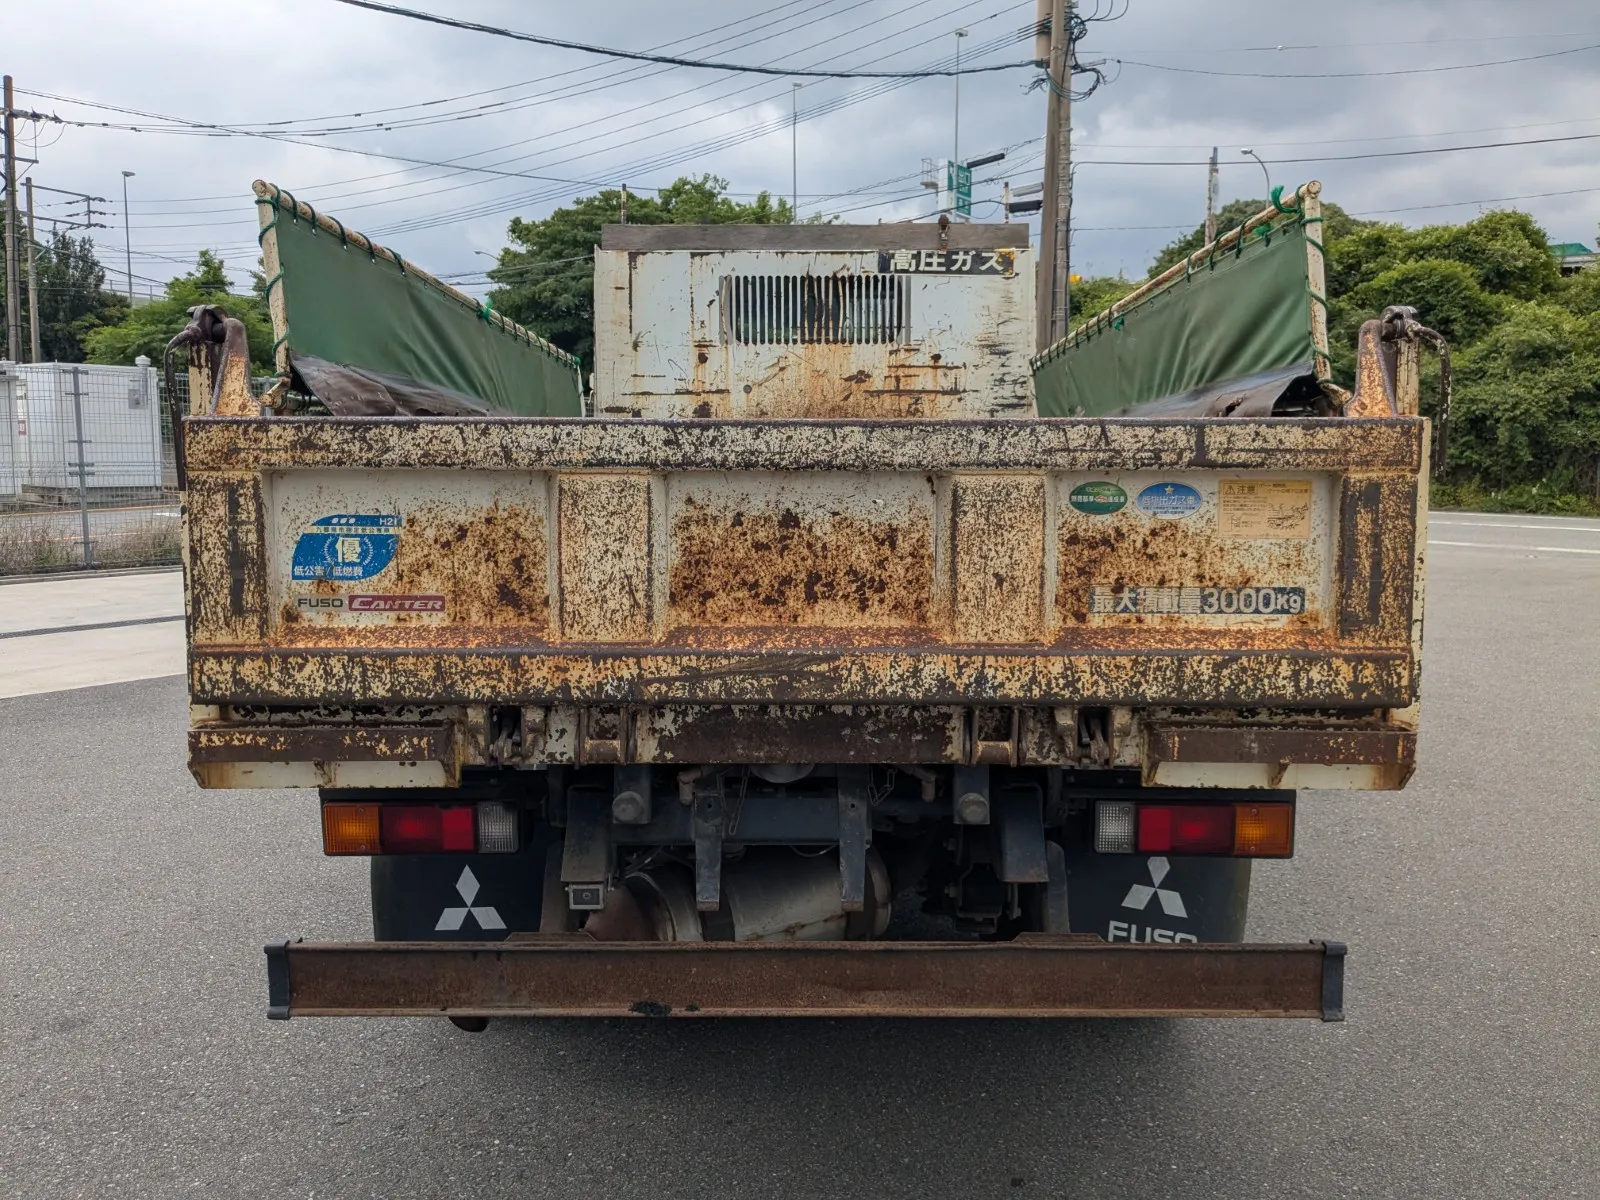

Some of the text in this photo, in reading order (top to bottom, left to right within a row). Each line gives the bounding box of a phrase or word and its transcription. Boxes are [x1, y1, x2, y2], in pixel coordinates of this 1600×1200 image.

[890, 249, 1005, 272] 高圧ガス
[335, 536, 361, 563] 優
[297, 597, 443, 610] FUSO CANTER
